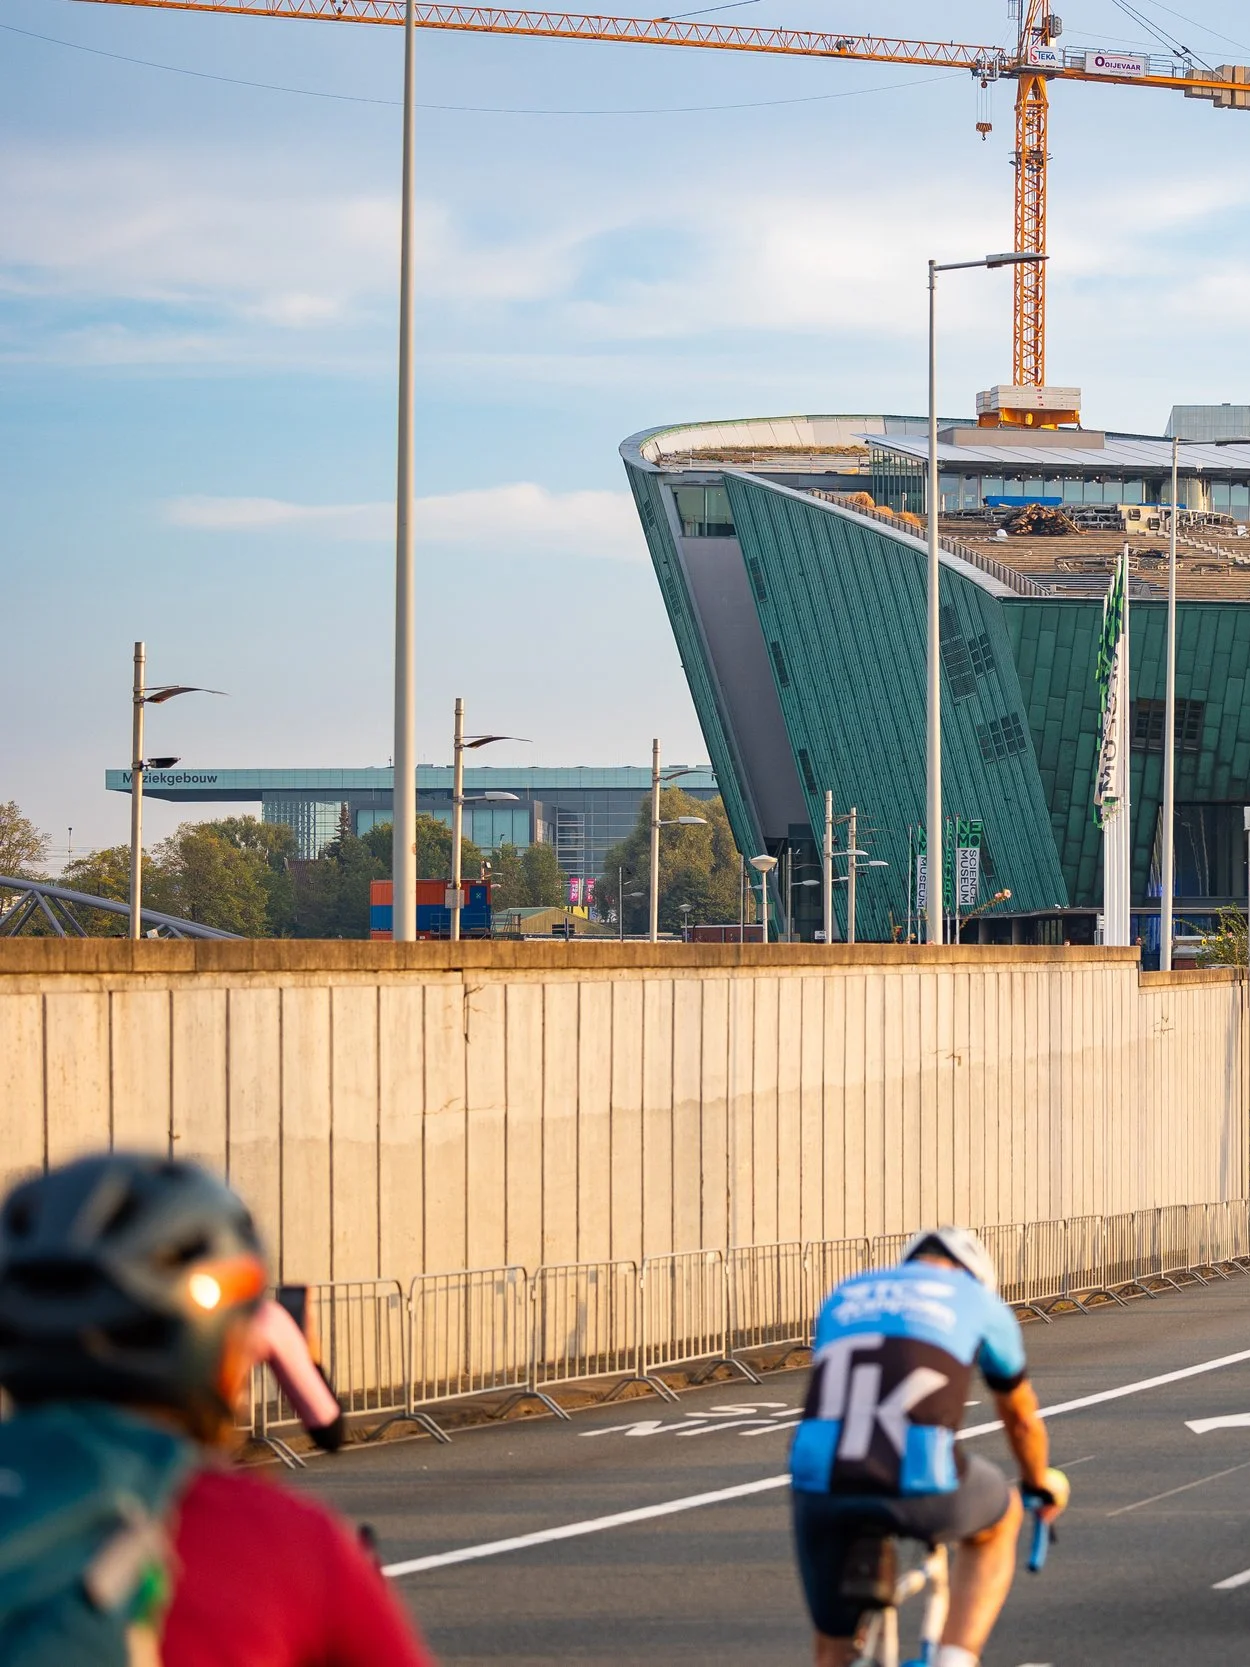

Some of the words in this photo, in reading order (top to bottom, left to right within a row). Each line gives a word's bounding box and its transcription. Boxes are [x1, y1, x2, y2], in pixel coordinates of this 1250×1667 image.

[122, 772, 218, 786] Mziekgebouw
[960, 849, 969, 904] MUSEUM
[969, 849, 977, 904] SCIENCE
